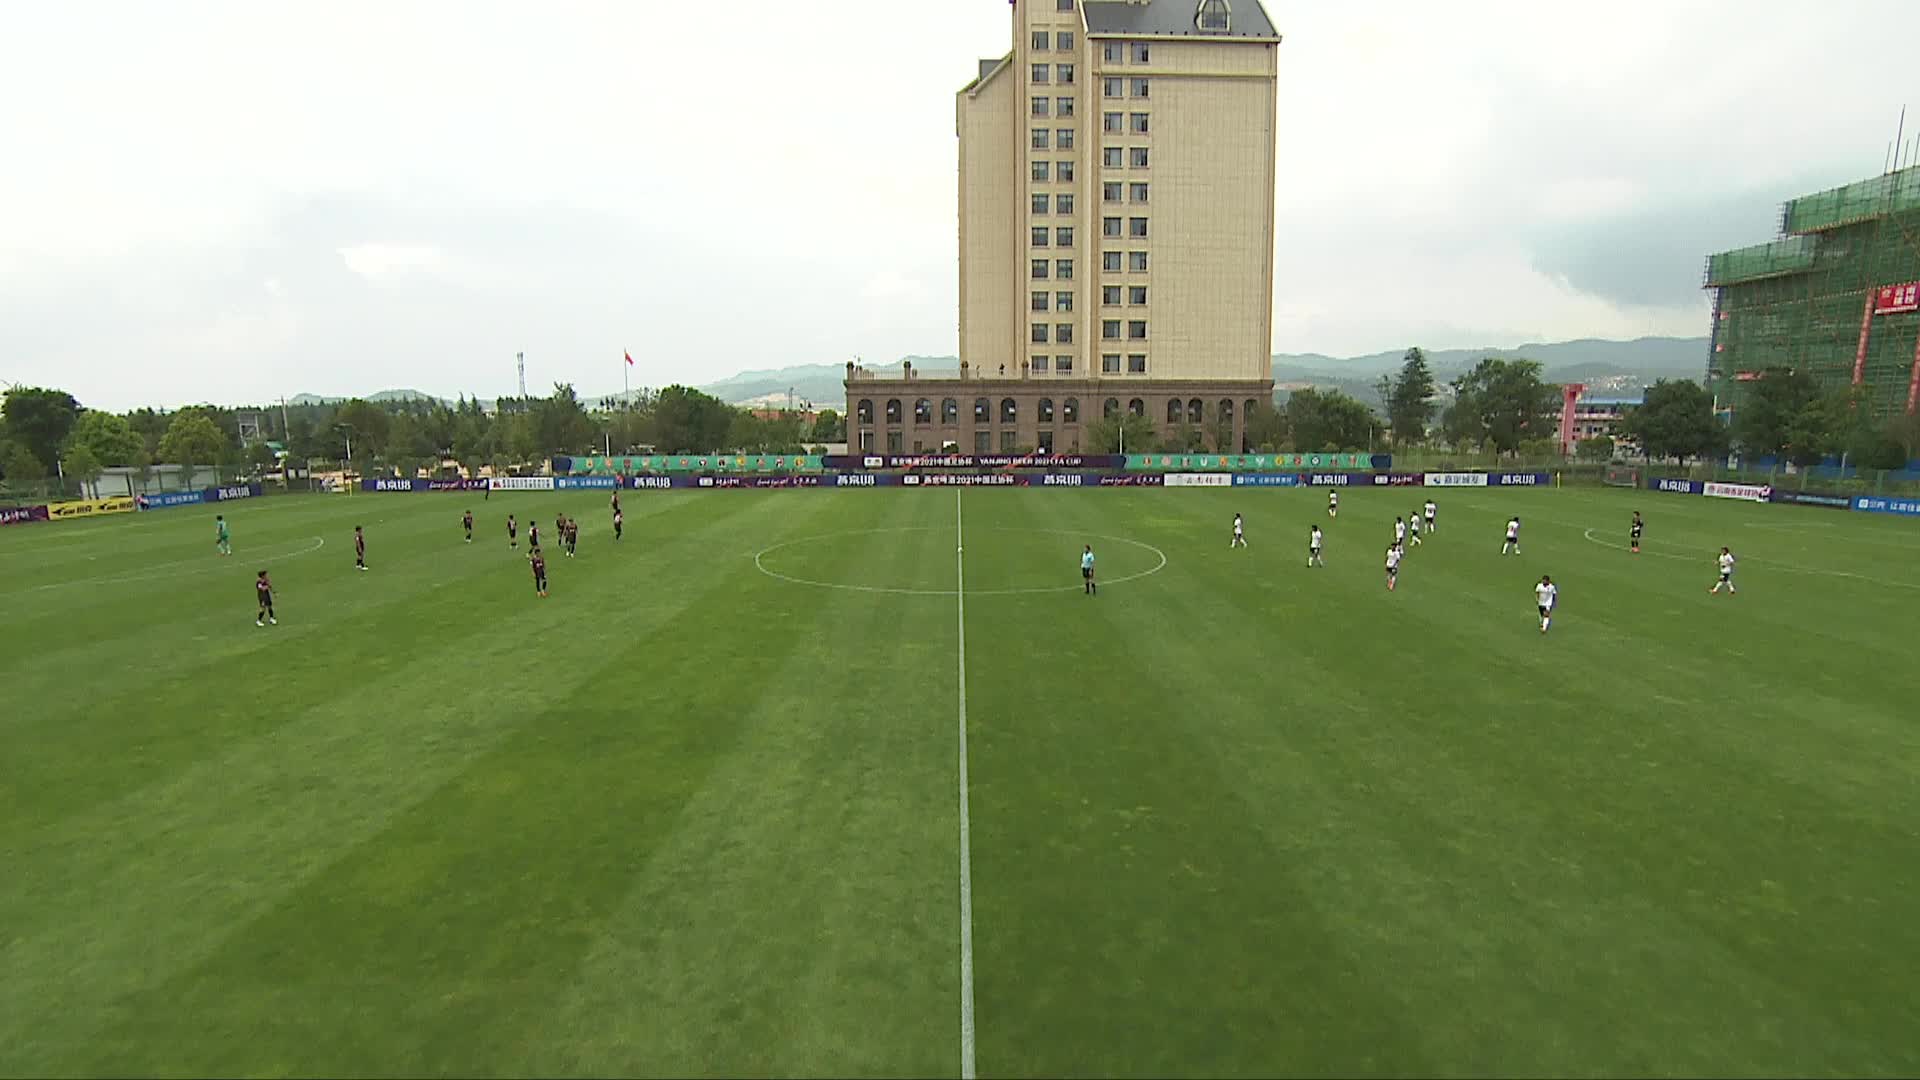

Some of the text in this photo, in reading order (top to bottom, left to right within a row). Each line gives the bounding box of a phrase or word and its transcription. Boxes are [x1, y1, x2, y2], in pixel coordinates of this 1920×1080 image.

[979, 457, 1011, 465] YANJING
[1012, 457, 1033, 465] BEER
[1034, 457, 1049, 465] 2021
[1066, 457, 1082, 465] CUP
